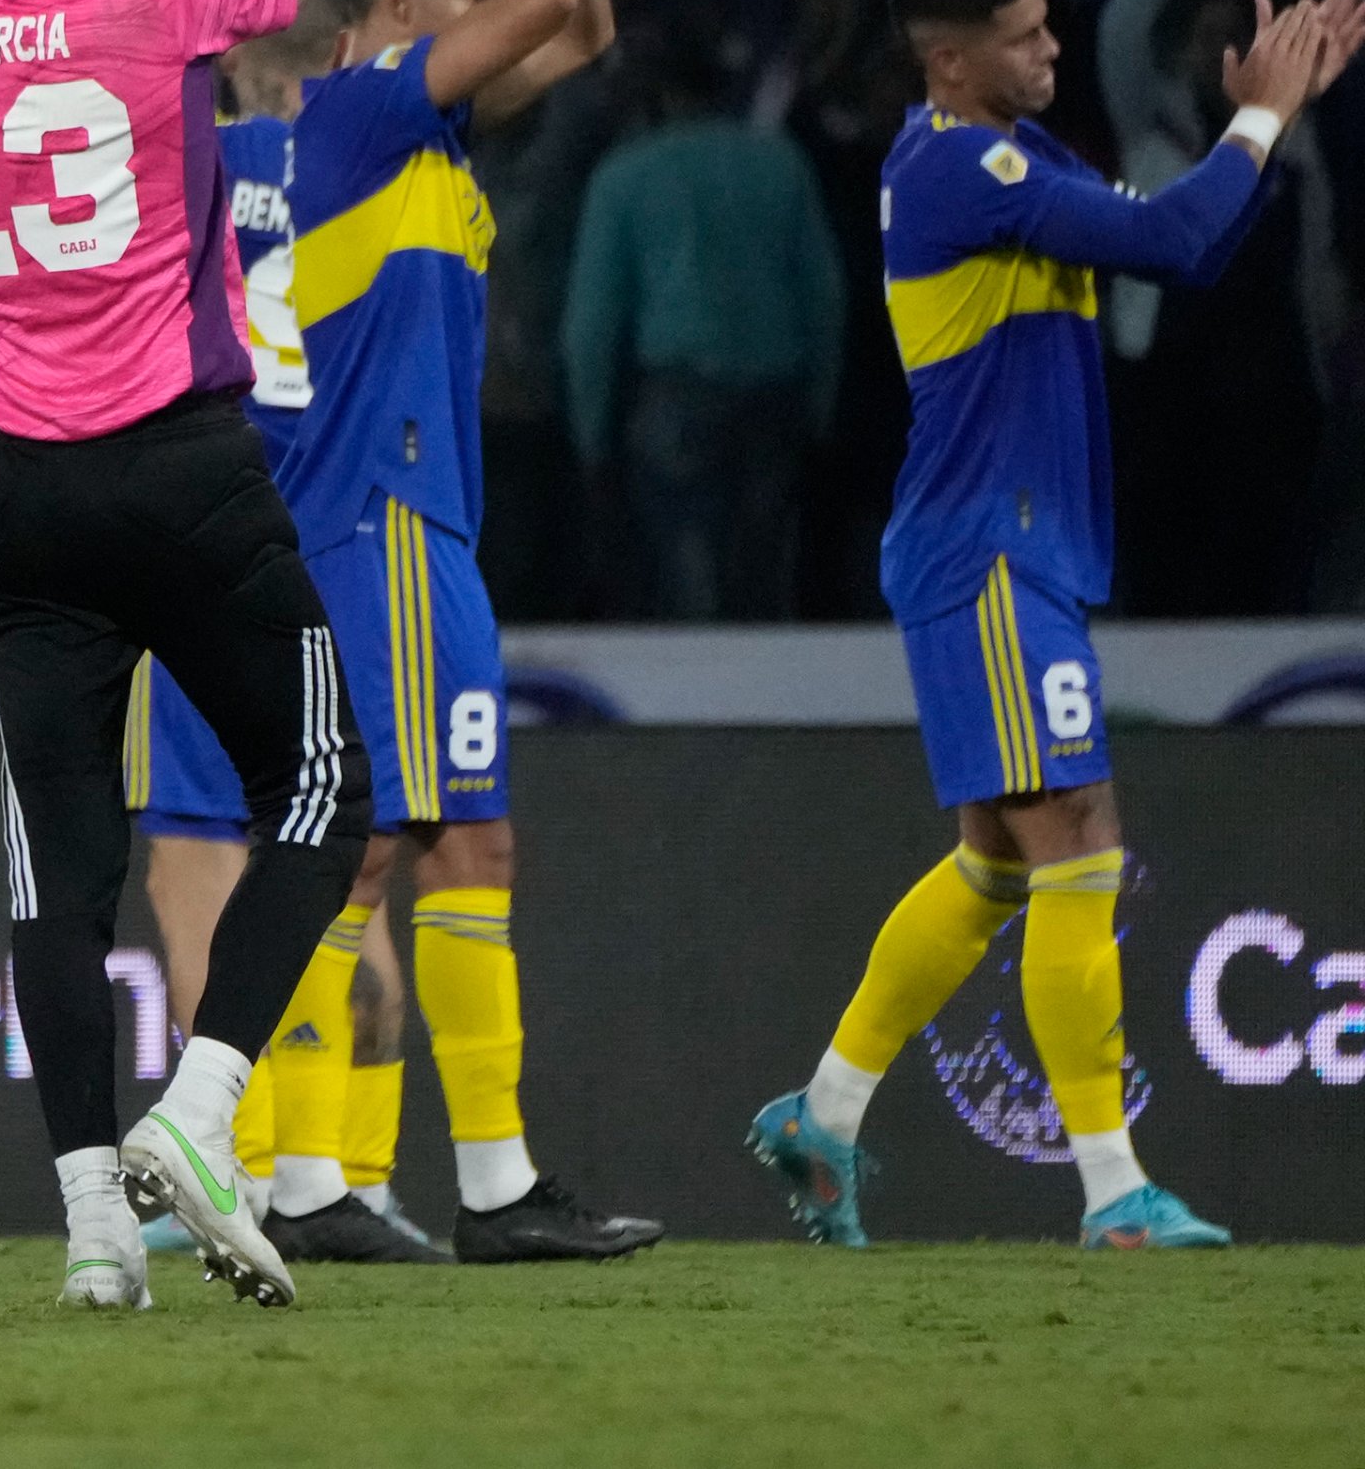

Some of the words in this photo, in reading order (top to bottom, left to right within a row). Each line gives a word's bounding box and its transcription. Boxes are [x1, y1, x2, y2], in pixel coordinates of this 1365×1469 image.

[59, 238, 97, 255] CABJ
[448, 689, 498, 771] 8
[1041, 660, 1093, 740] 6
[1185, 907, 1365, 1085] Ca
